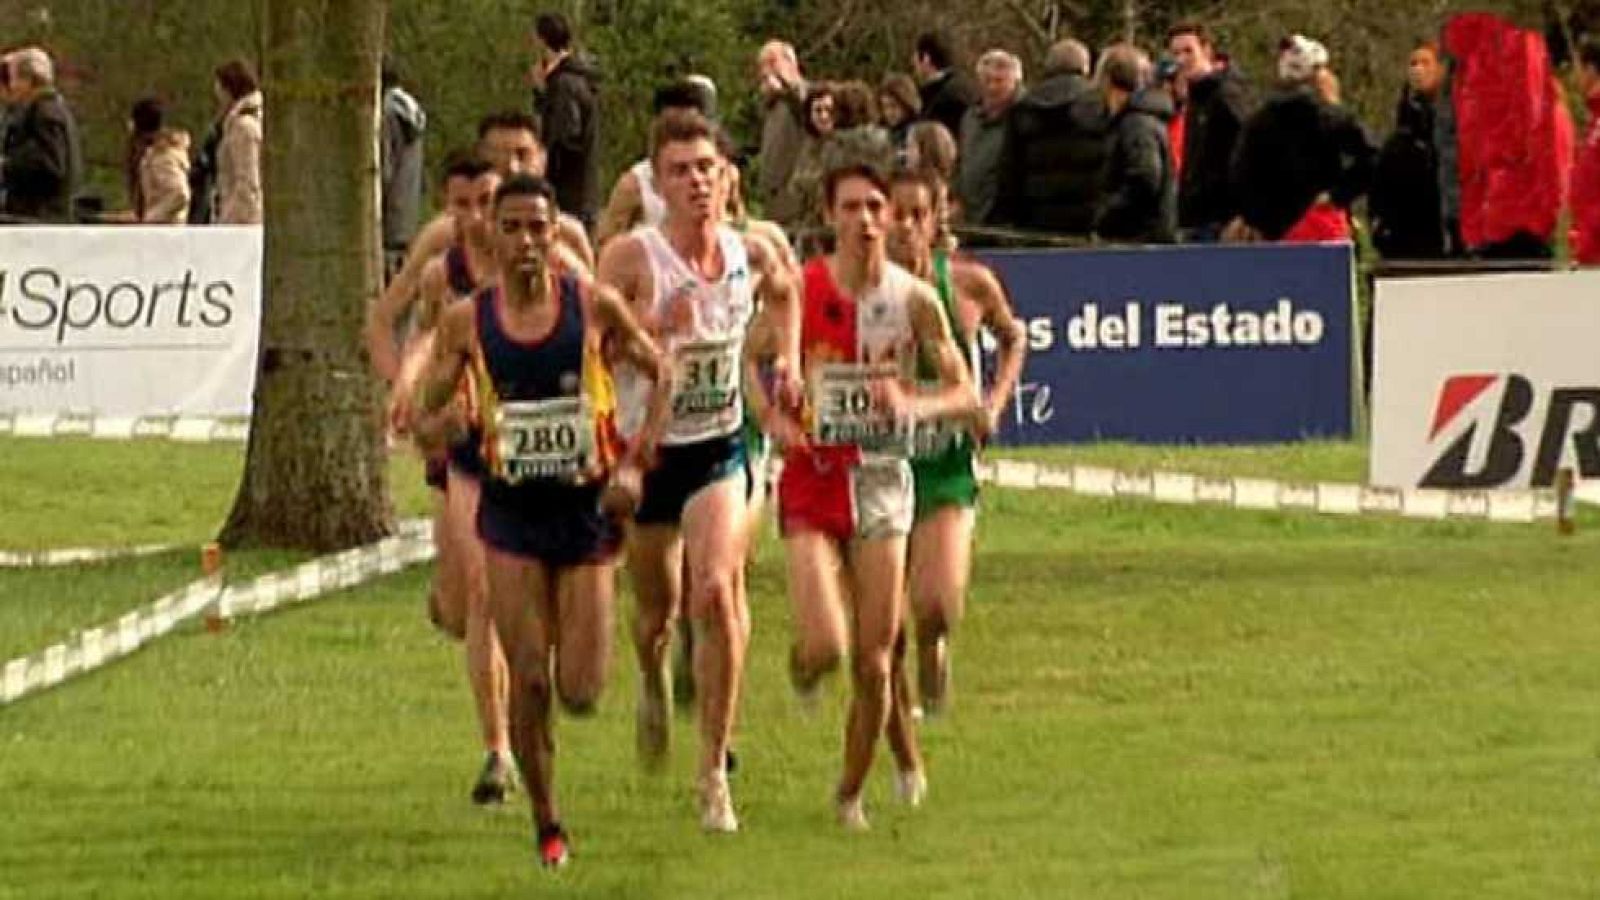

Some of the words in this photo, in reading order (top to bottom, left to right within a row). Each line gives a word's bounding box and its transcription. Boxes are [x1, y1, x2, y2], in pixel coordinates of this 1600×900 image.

[1067, 303, 1140, 348] del
[1154, 299, 1324, 347] Estado
[512, 423, 575, 456] 280
